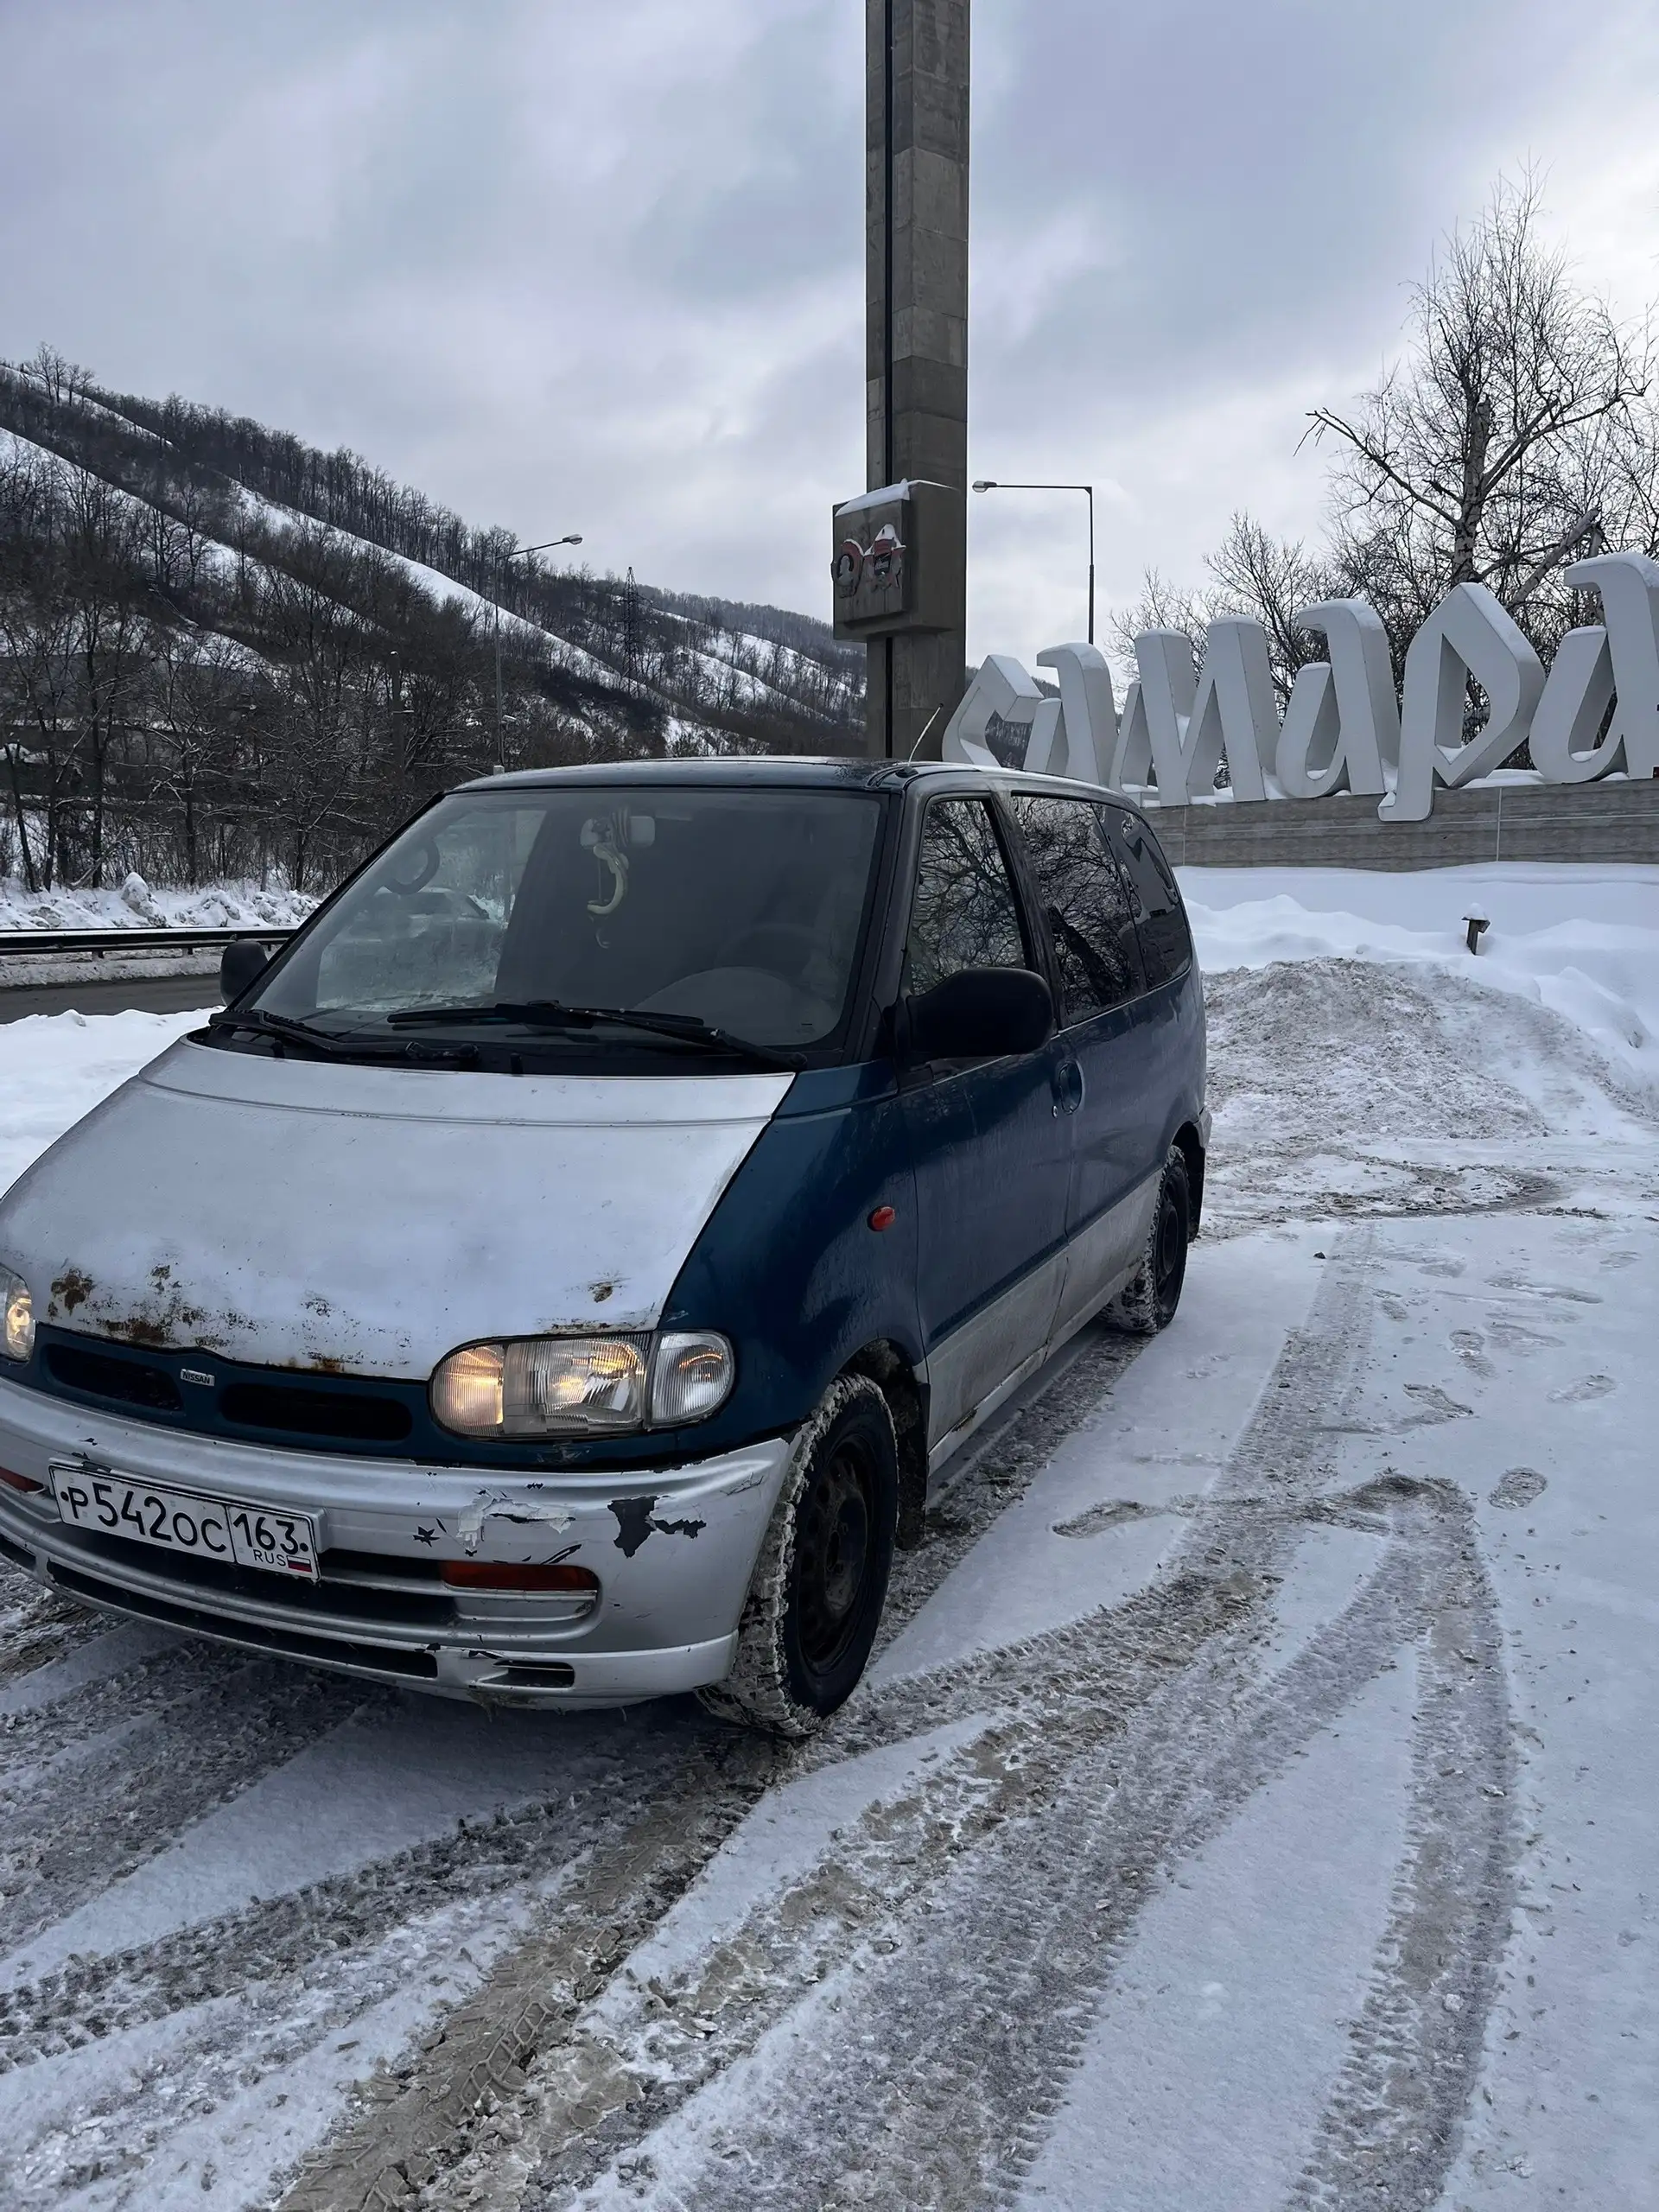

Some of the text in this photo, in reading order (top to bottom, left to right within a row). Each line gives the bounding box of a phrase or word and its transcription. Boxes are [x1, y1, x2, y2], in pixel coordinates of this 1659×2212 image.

[181, 1370, 211, 1384] NISSAN
[67, 1482, 300, 1554] Р542ОС 163
[253, 1550, 286, 1567] RUS
